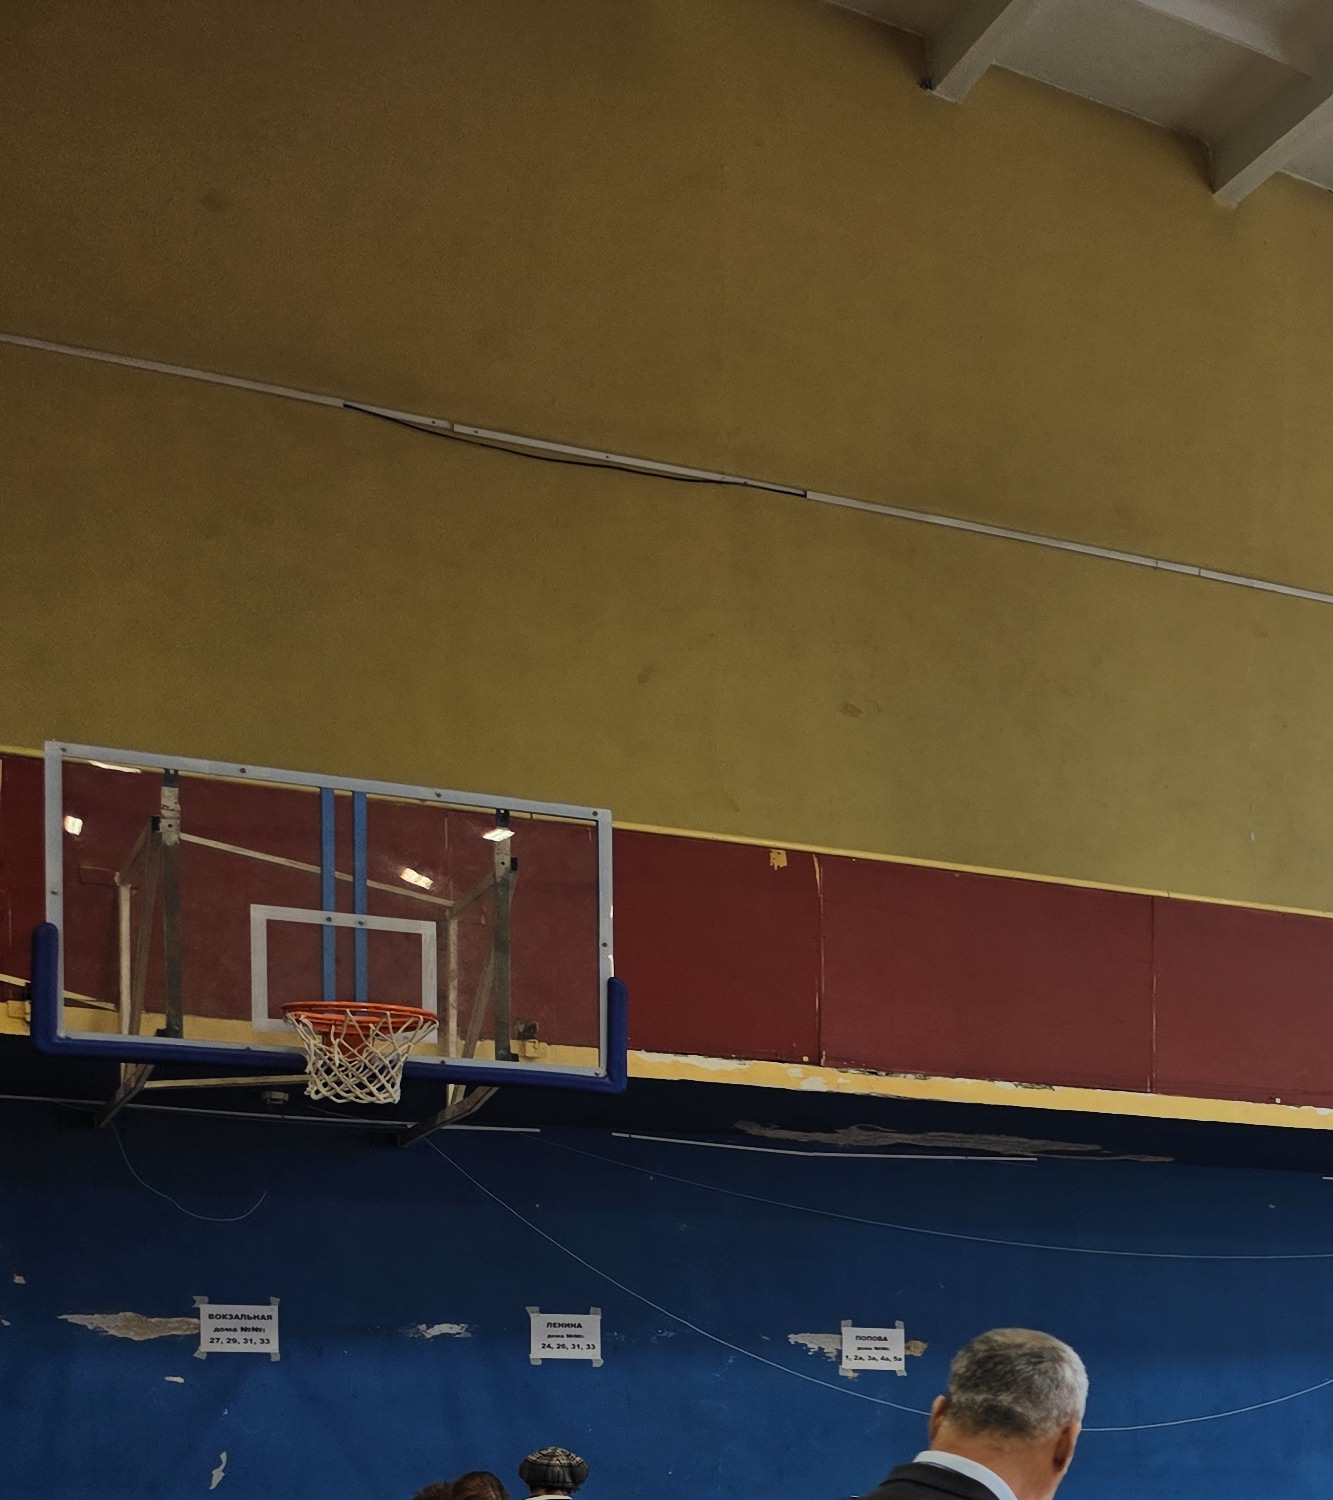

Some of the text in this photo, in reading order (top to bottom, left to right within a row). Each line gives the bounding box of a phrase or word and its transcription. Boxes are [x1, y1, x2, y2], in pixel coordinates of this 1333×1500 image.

[208, 1337, 224, 1345] 27,
[226, 1337, 241, 1345] 29,
[541, 1342, 554, 1350] 24,
